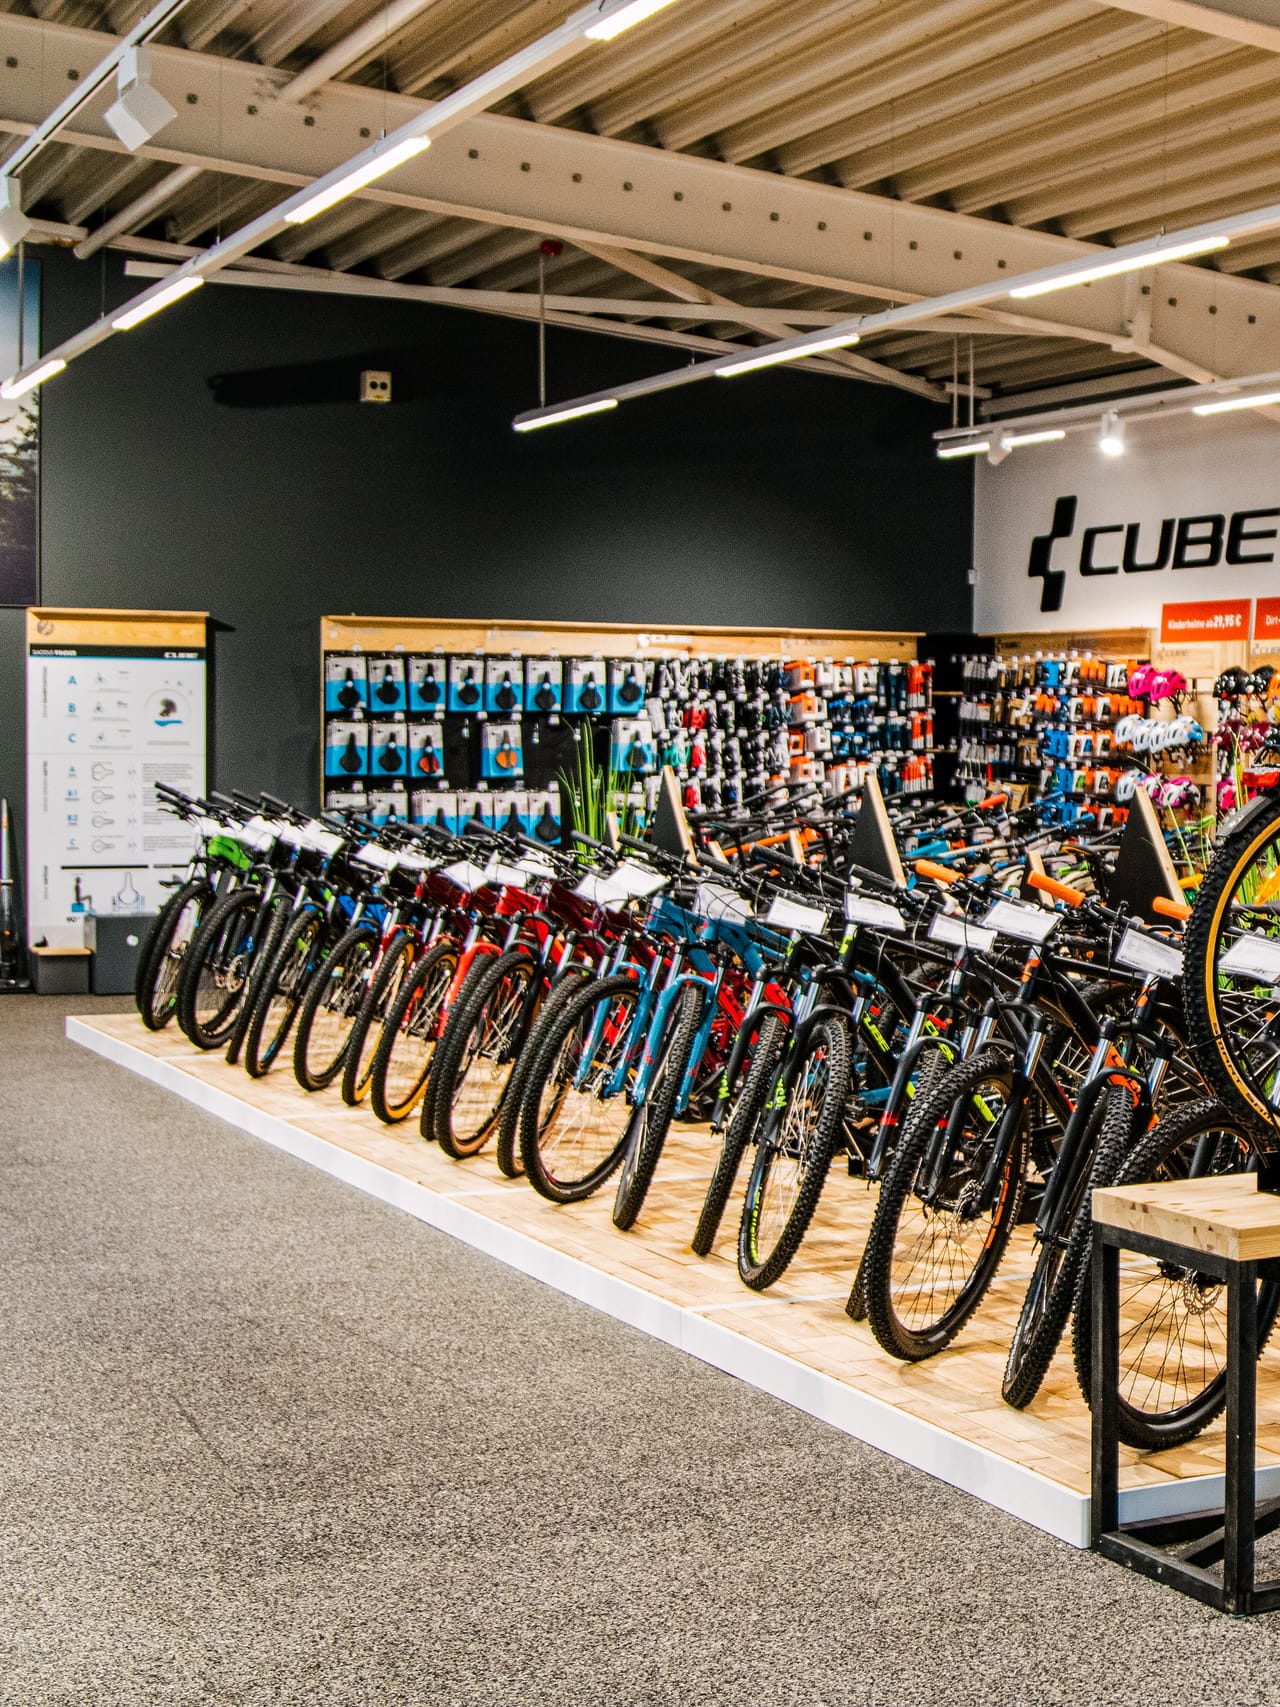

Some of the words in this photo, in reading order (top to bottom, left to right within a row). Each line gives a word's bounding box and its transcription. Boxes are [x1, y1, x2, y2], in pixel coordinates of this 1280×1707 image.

[1213, 614, 1235, 629] 29,95
[1235, 614, 1242, 627] €
[68, 675, 77, 685] A
[68, 703, 76, 713] B
[68, 733, 76, 743] C
